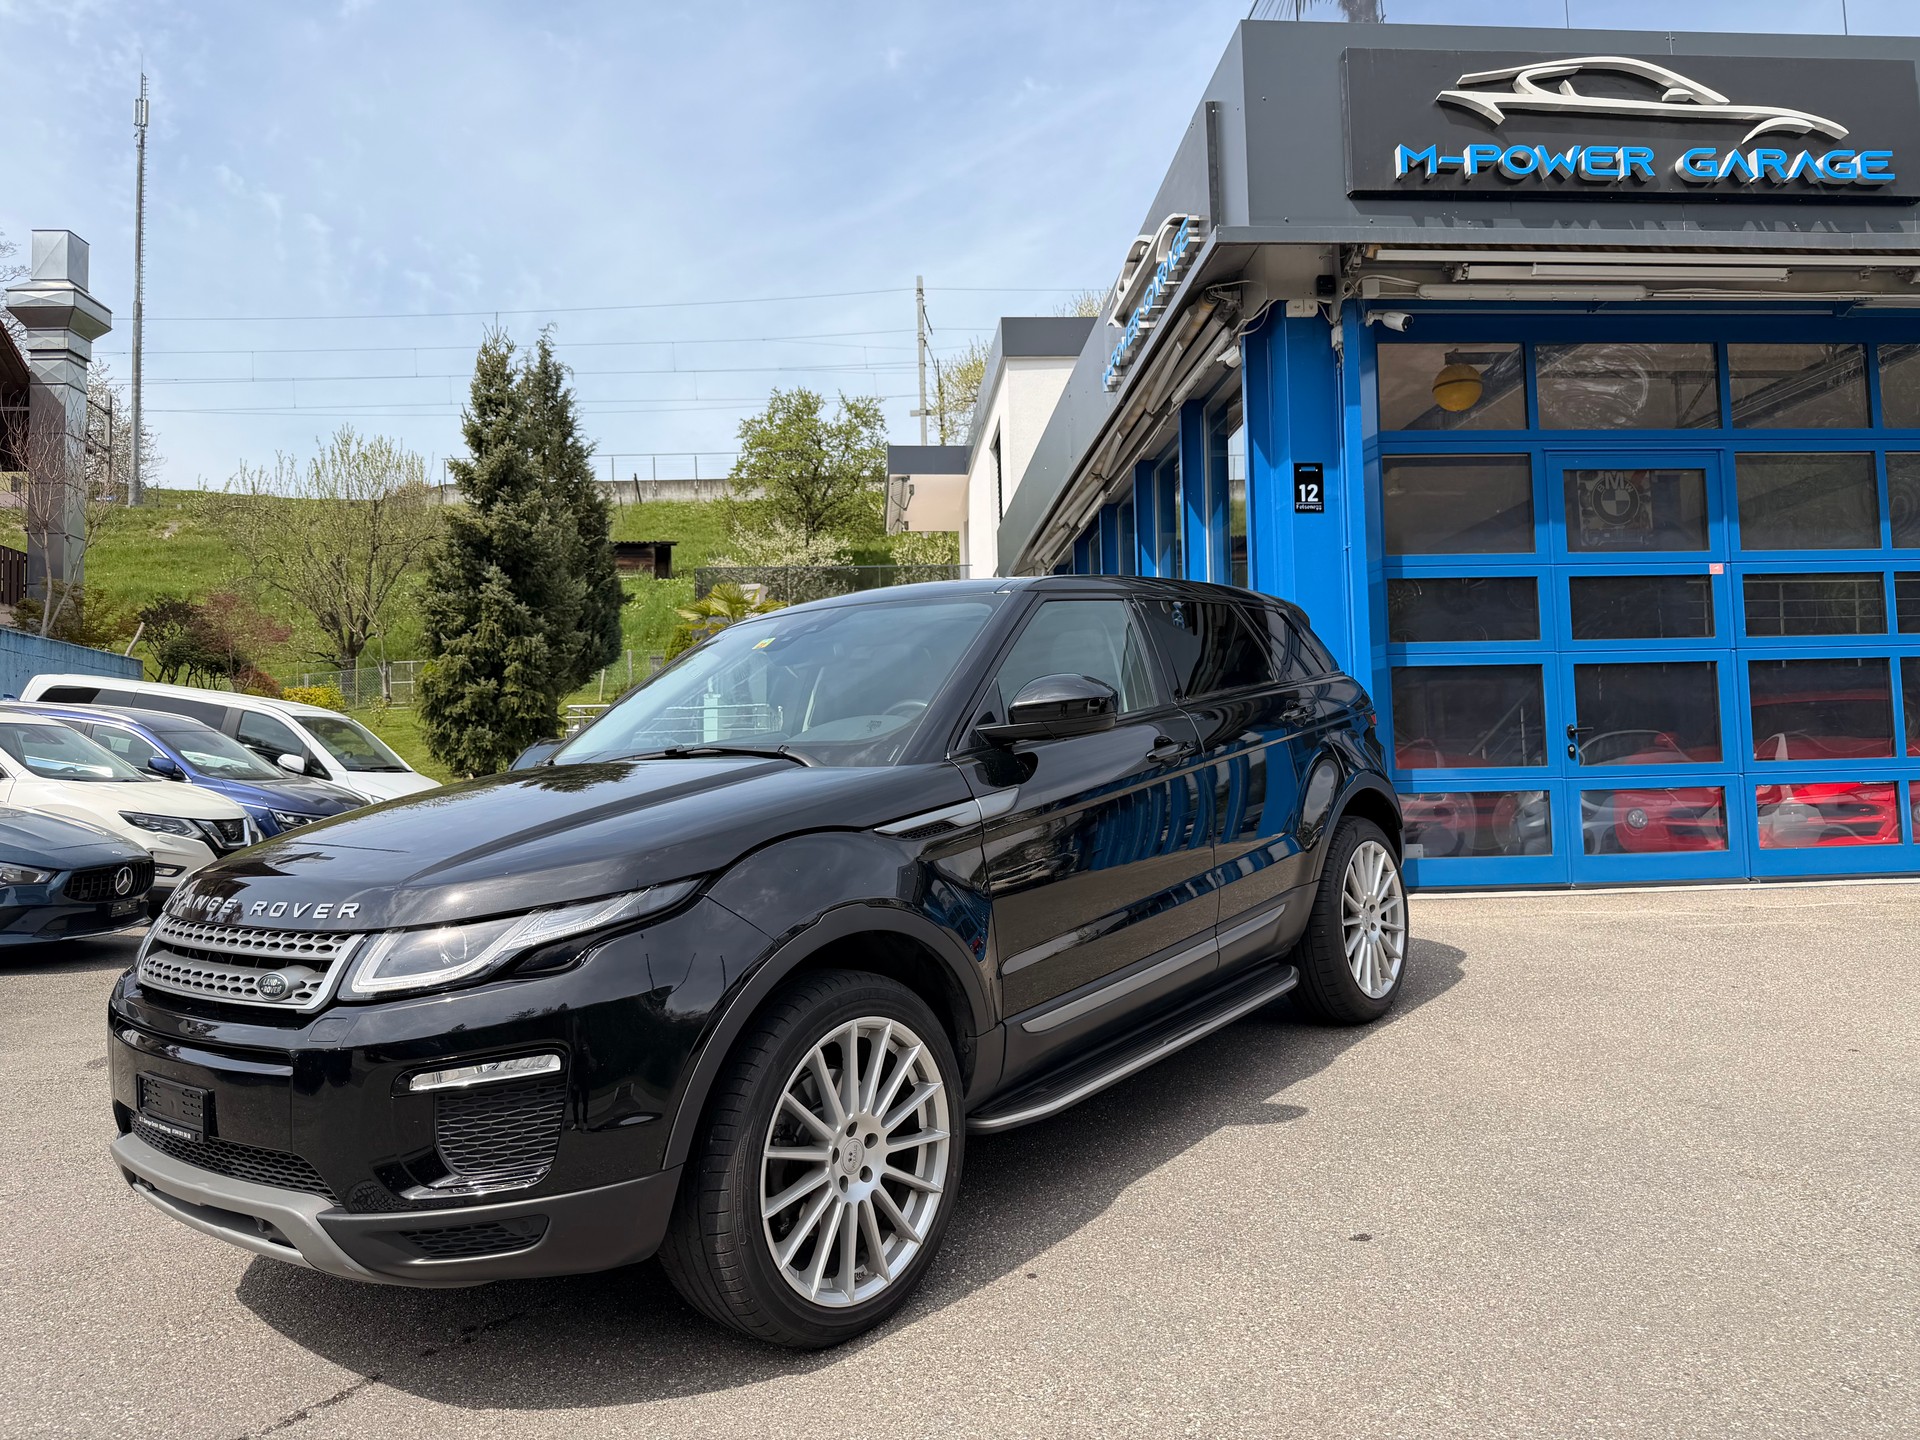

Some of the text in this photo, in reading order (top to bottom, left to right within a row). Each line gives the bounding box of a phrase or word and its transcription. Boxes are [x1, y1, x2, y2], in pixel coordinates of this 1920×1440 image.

[1396, 144, 1896, 183] M-POWER GARAGE
[1299, 484, 1319, 502] 12
[172, 891, 360, 919] RANGE ROVER
